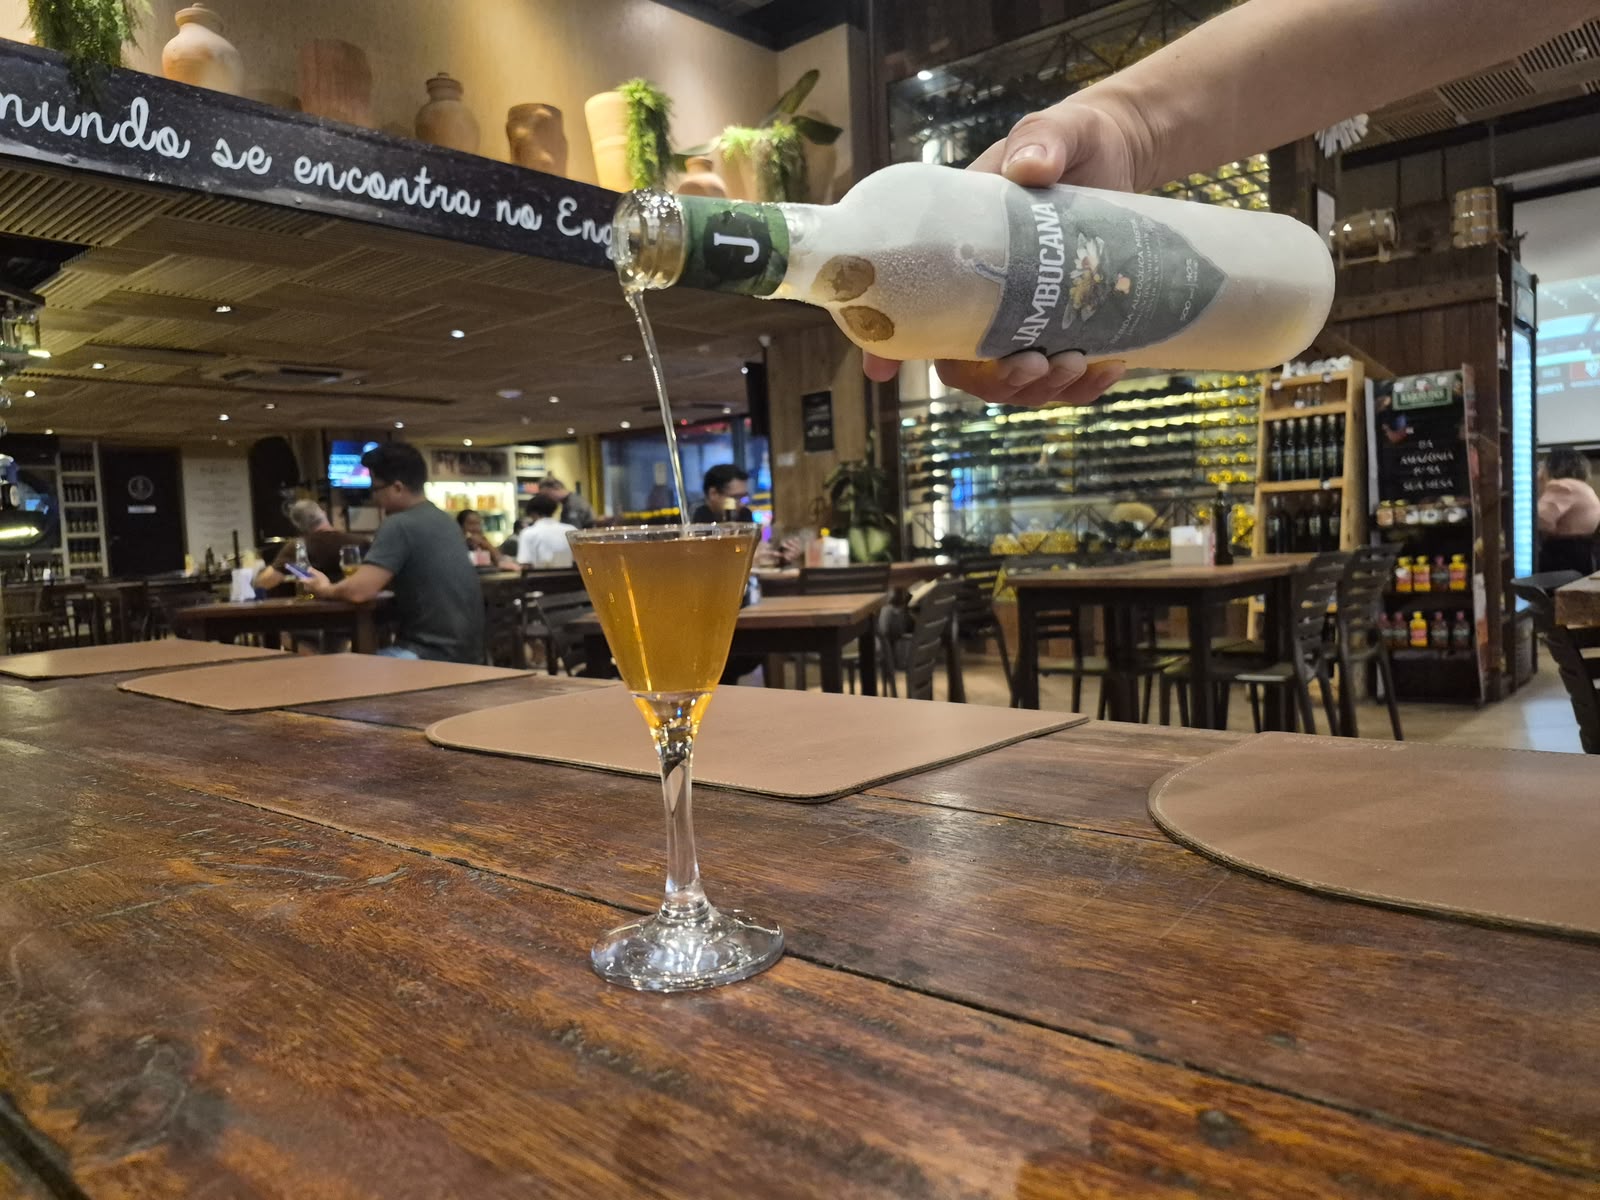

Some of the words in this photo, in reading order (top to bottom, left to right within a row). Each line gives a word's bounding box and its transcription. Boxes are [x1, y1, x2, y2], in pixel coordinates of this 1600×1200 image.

[211, 138, 273, 175] se
[293, 155, 481, 218] encontra
[496, 199, 543, 231] no
[713, 232, 760, 263] J
[1011, 202, 1065, 347] JAMBUCANA
